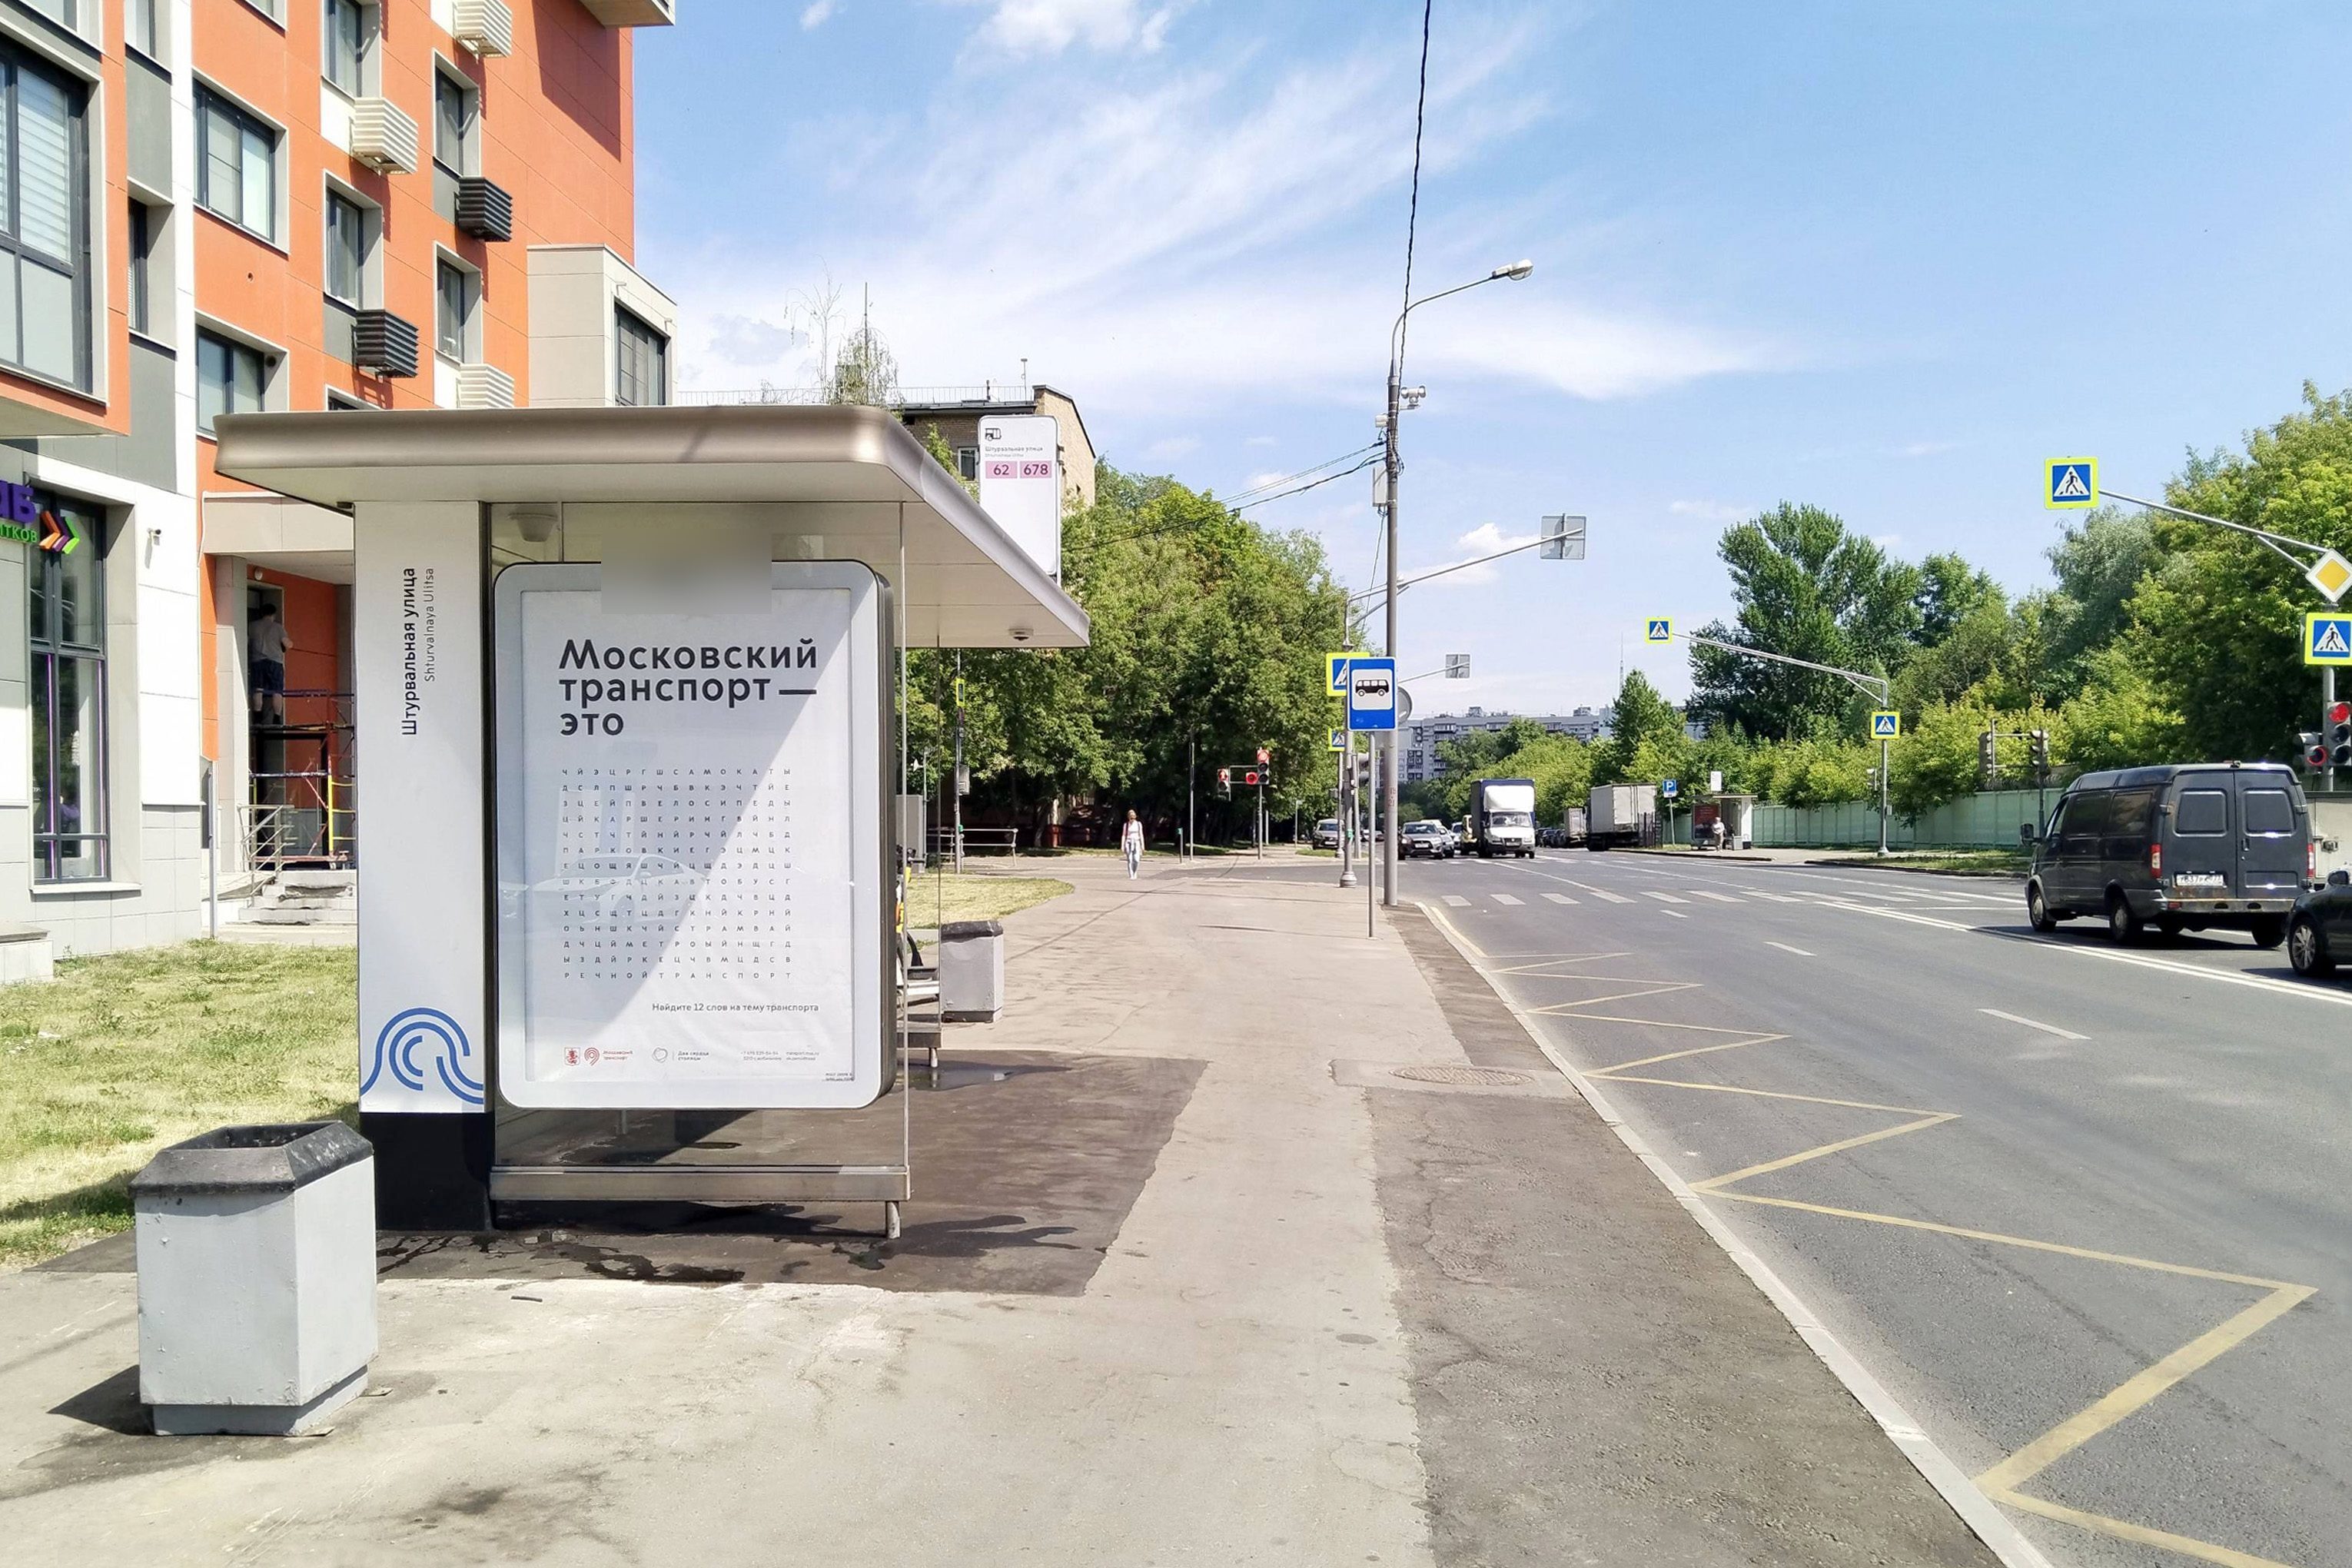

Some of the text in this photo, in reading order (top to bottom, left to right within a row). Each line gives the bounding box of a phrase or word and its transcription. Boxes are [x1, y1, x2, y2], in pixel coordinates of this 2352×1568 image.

[993, 463, 1048, 476] 62 678
[423, 568, 437, 682] Shturvalnaya Ulitsa
[401, 568, 421, 736] Штурвальная улица
[559, 637, 817, 669] Московский
[560, 713, 624, 736] это
[1666, 781, 1674, 791] P
[652, 1002, 819, 1014] Найдите 12 слов на тему транспорта
